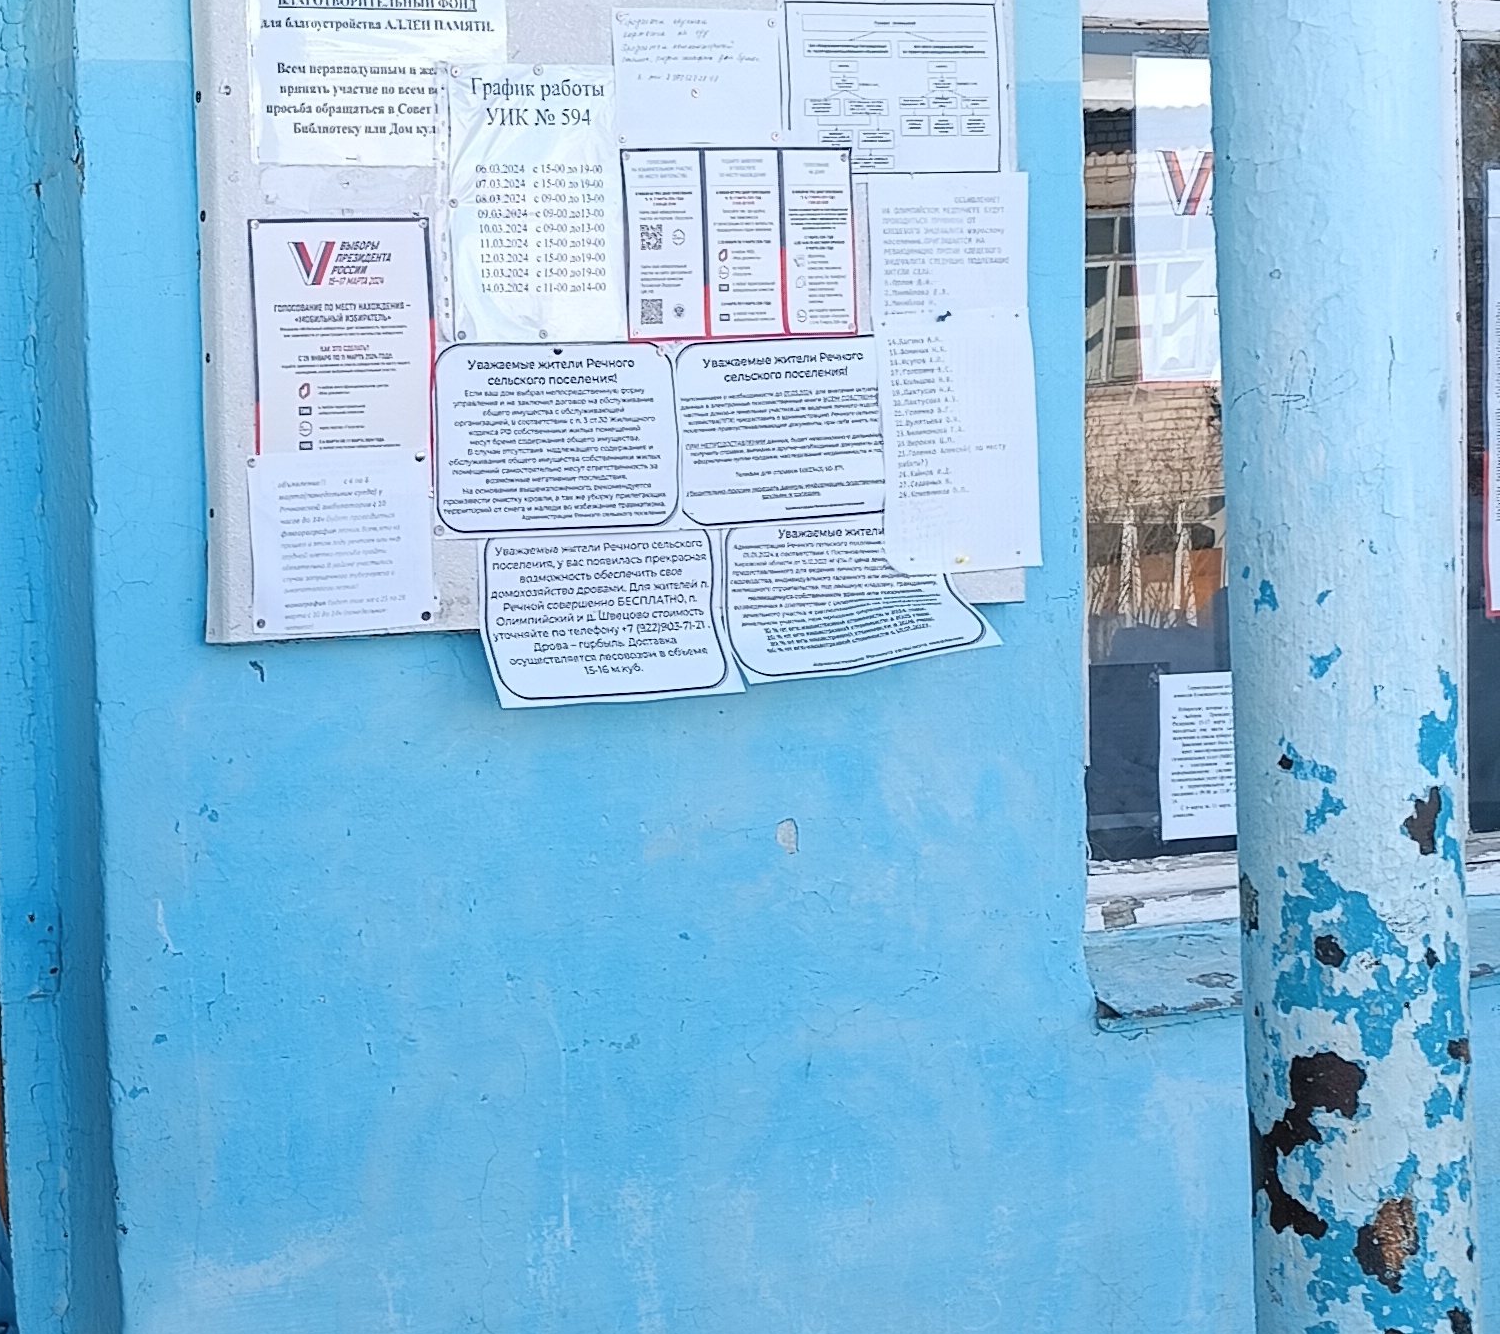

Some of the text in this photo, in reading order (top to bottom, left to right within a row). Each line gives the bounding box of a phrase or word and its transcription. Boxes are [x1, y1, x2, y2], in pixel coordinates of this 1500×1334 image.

[261, 17, 494, 32] для благоустройства АЛЛЕИ ПАМЯТИ.
[278, 62, 305, 74] Всем
[310, 65, 405, 77] неравнодушным
[410, 67, 416, 75] и
[280, 85, 329, 96] принять
[333, 85, 378, 97] участие
[382, 85, 394, 94] по
[398, 86, 425, 94] всем
[471, 78, 604, 101] График работы
[266, 103, 431, 117] просьба обращаться в Совет
[486, 108, 591, 126] УИК № 594
[294, 122, 361, 136] Библиотеку
[365, 125, 386, 134] или
[389, 123, 413, 135] Дом
[476, 164, 525, 173] 06.03.2024
[541, 164, 565, 173] 15-00
[580, 164, 602, 173] 19-00
[476, 179, 525, 188] 07.03.2024
[542, 179, 565, 188] 15-00
[581, 179, 603, 188] 19-00
[476, 194, 526, 203] 08.03.2024
[542, 194, 566, 203] 09-00
[582, 194, 604, 203] 13-00
[478, 209, 527, 218] 09.03.2024
[543, 209, 567, 218] 09-00
[480, 224, 527, 233] 10.03.2024
[544, 224, 567, 233] 09-00
[340, 241, 380, 250] ВЫБОРЫ
[481, 239, 528, 248] 11.03.2024
[545, 238, 567, 248] 15-00
[335, 253, 391, 263] ПРЕЗИДЕНТА
[481, 254, 529, 263] 12.03.2024
[545, 253, 567, 262] 15-00
[331, 265, 367, 275] РОССИИ
[481, 269, 529, 278] 13.03.2024
[545, 268, 567, 277] 15-00
[482, 284, 529, 293] 14.03.2024
[545, 283, 567, 292] 11-00
[274, 304, 322, 312] ГОЛОСОВАНИЕ
[335, 303, 356, 311] МЕСТУ
[468, 358, 635, 370] Уважаемые жители Речного
[703, 352, 863, 368] Уважаемые жители Речного
[488, 373, 617, 385] сельского поселения!
[724, 366, 848, 382] сельского поселения!
[778, 529, 842, 539] Уважаемые
[495, 541, 702, 556] Уважаемые жители Речного сельского
[557, 560, 564, 569] у
[567, 559, 584, 567] вас
[587, 557, 642, 565] появилась
[645, 554, 706, 565] прекрасная
[520, 568, 682, 583] возможность обеспечить свое
[490, 587, 574, 599] домохозяйство
[630, 583, 650, 593] Для
[653, 580, 697, 590] жителей
[503, 601, 544, 611] Речной
[547, 599, 614, 610] совершенно
[617, 594, 687, 606] БЕСПЛАТНО,
[496, 613, 574, 626] Олимпийский
[652, 609, 704, 618] стоимость
[493, 629, 548, 642] уточняйте
[568, 626, 619, 636] телефону
[534, 642, 569, 652] Дрова
[628, 637, 677, 647] Доставка
[509, 655, 596, 667] осуществляется
[599, 651, 657, 661] лесовозом
